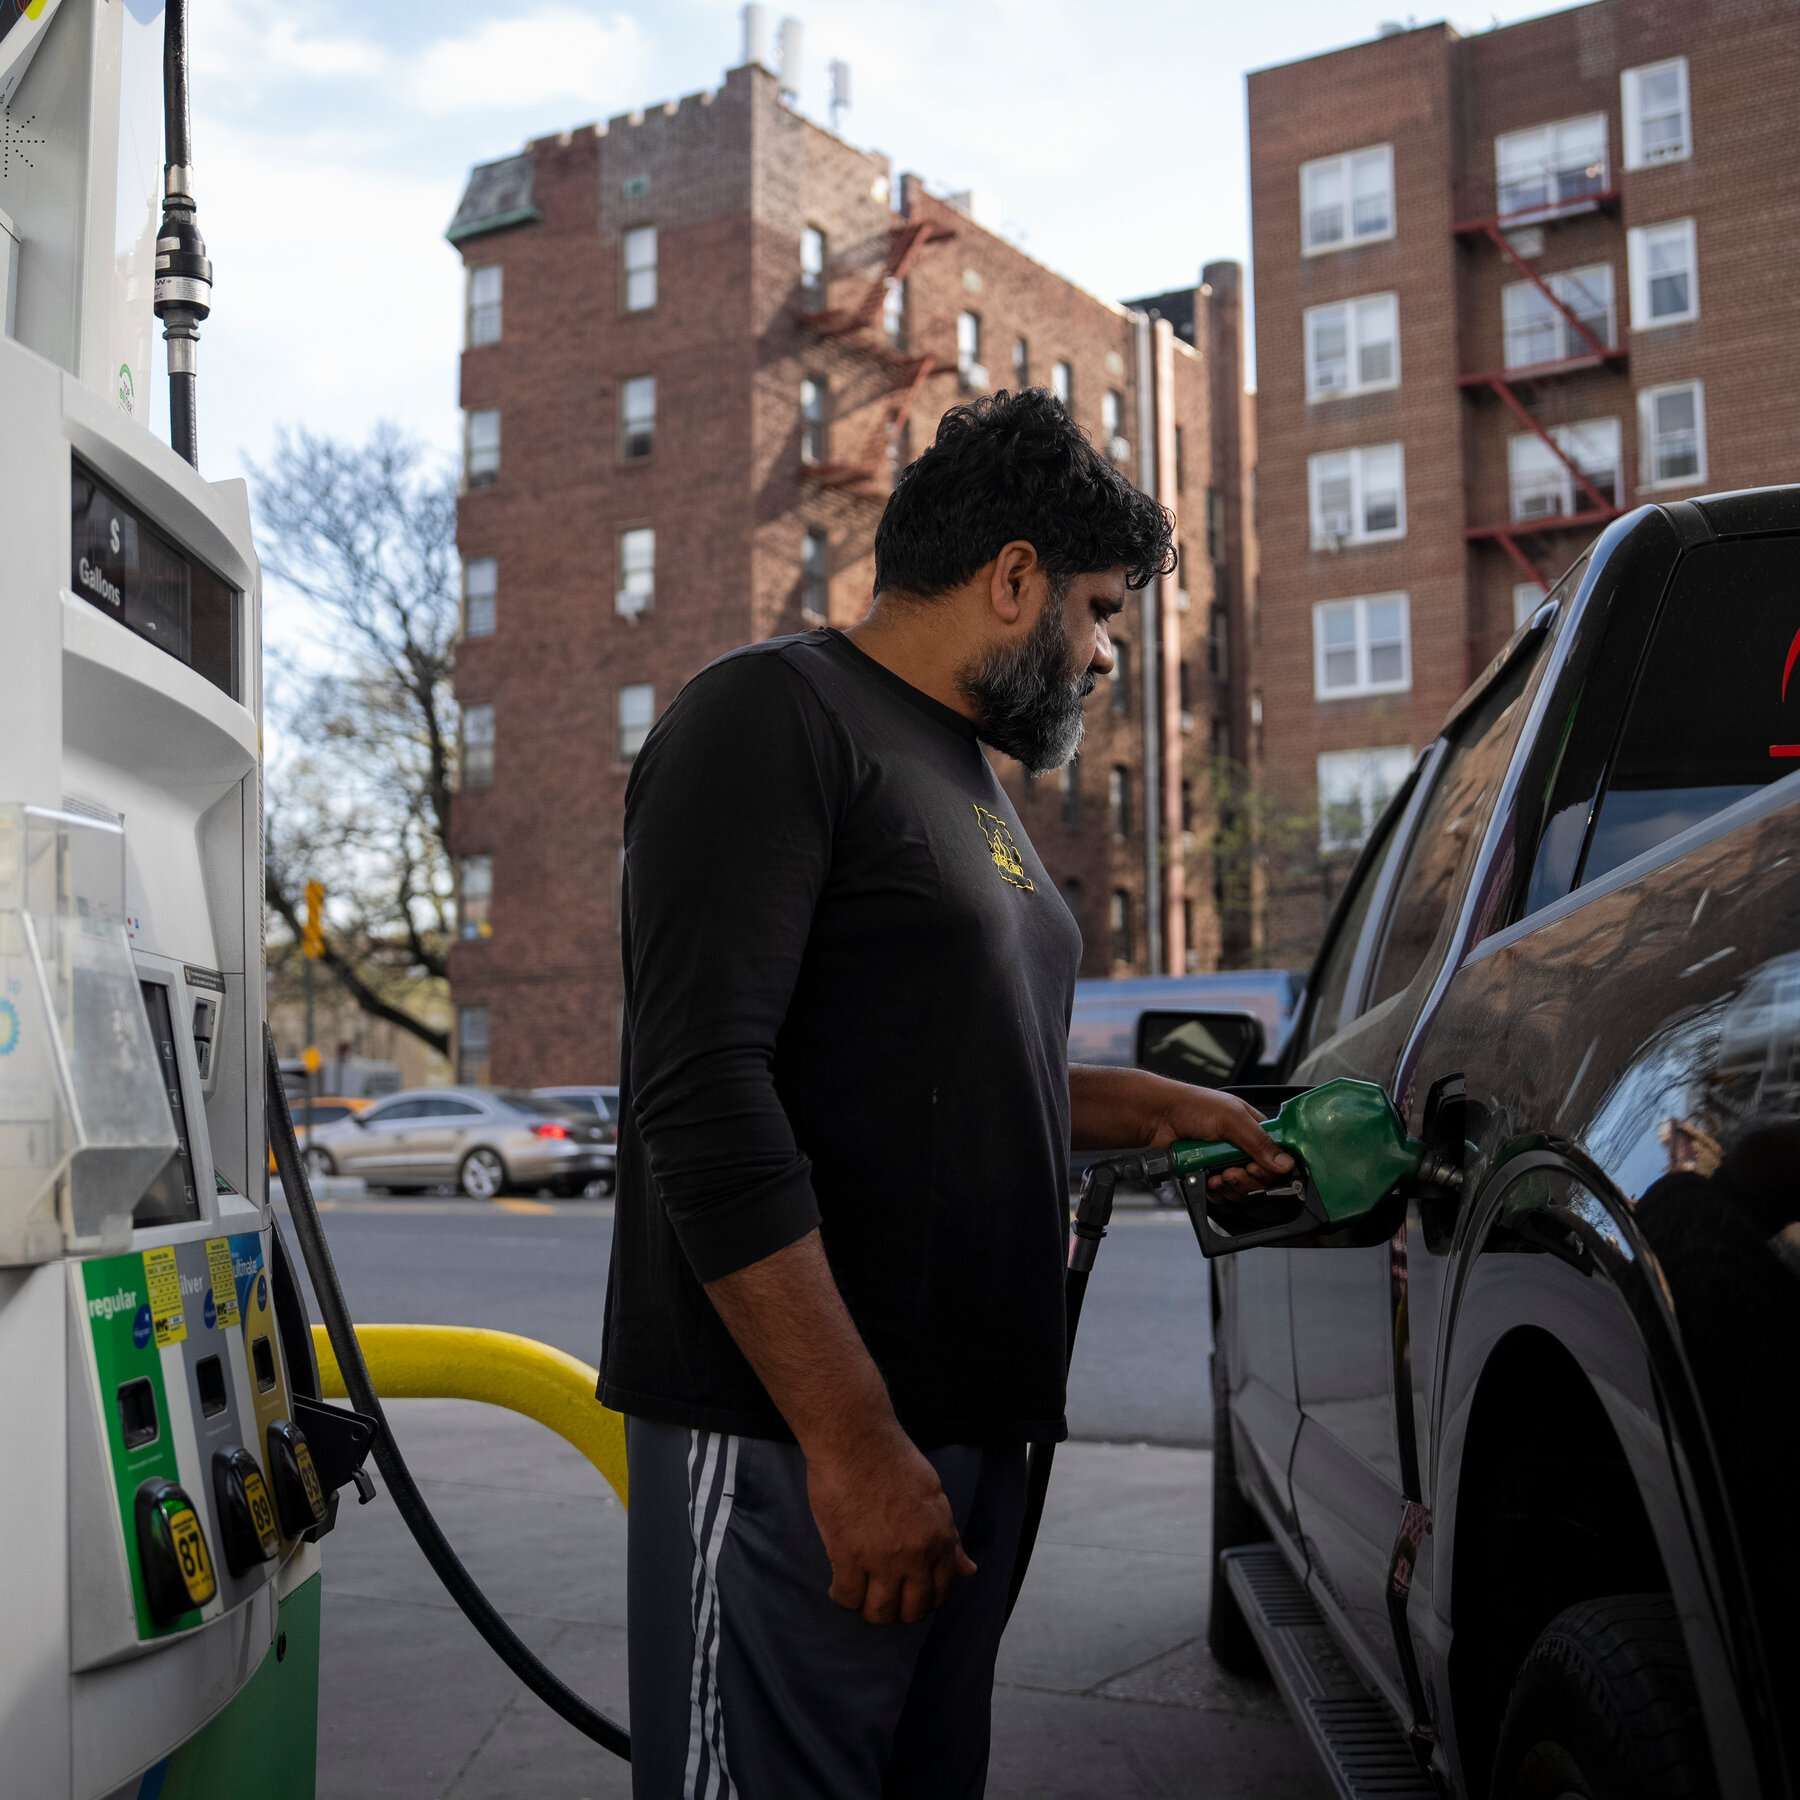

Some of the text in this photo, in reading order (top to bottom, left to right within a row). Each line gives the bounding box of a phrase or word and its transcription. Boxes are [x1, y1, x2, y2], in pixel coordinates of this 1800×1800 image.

[79, 557, 121, 605] Gallons
[180, 1274, 203, 1295] ilver
[232, 1256, 258, 1279] ultimate
[88, 1287, 137, 1320] regular
[302, 1463, 319, 1498] 93
[252, 1495, 271, 1532] 89
[179, 1531, 204, 1578] 87
